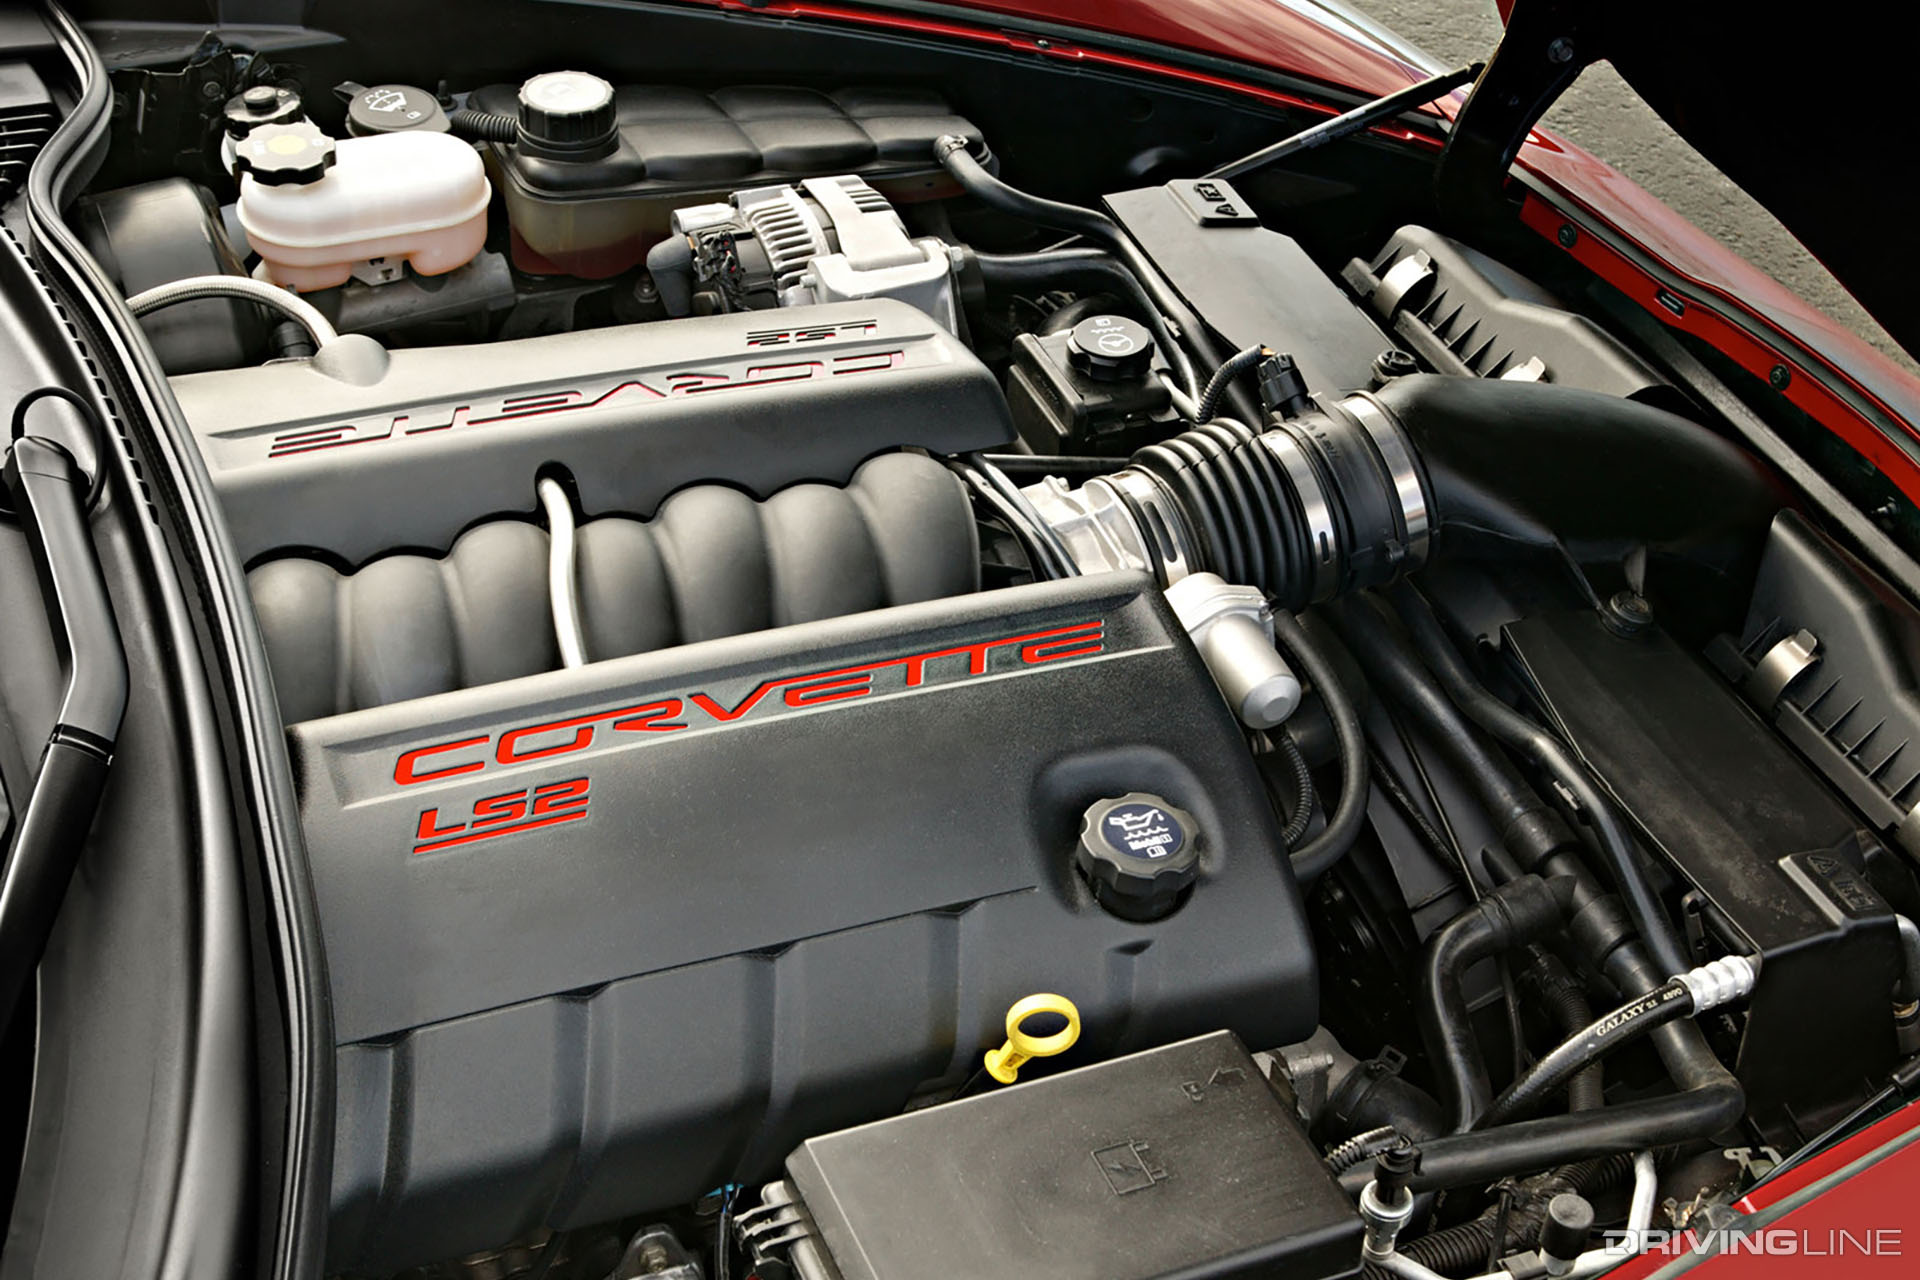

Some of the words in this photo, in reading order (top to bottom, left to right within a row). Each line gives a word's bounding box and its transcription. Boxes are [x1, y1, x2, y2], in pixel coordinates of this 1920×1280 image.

[268, 350, 904, 457] CORVETTE
[393, 619, 1102, 786] CORVETTE
[416, 777, 590, 840] LS2
[1597, 1002, 1645, 1036] GALAXY
